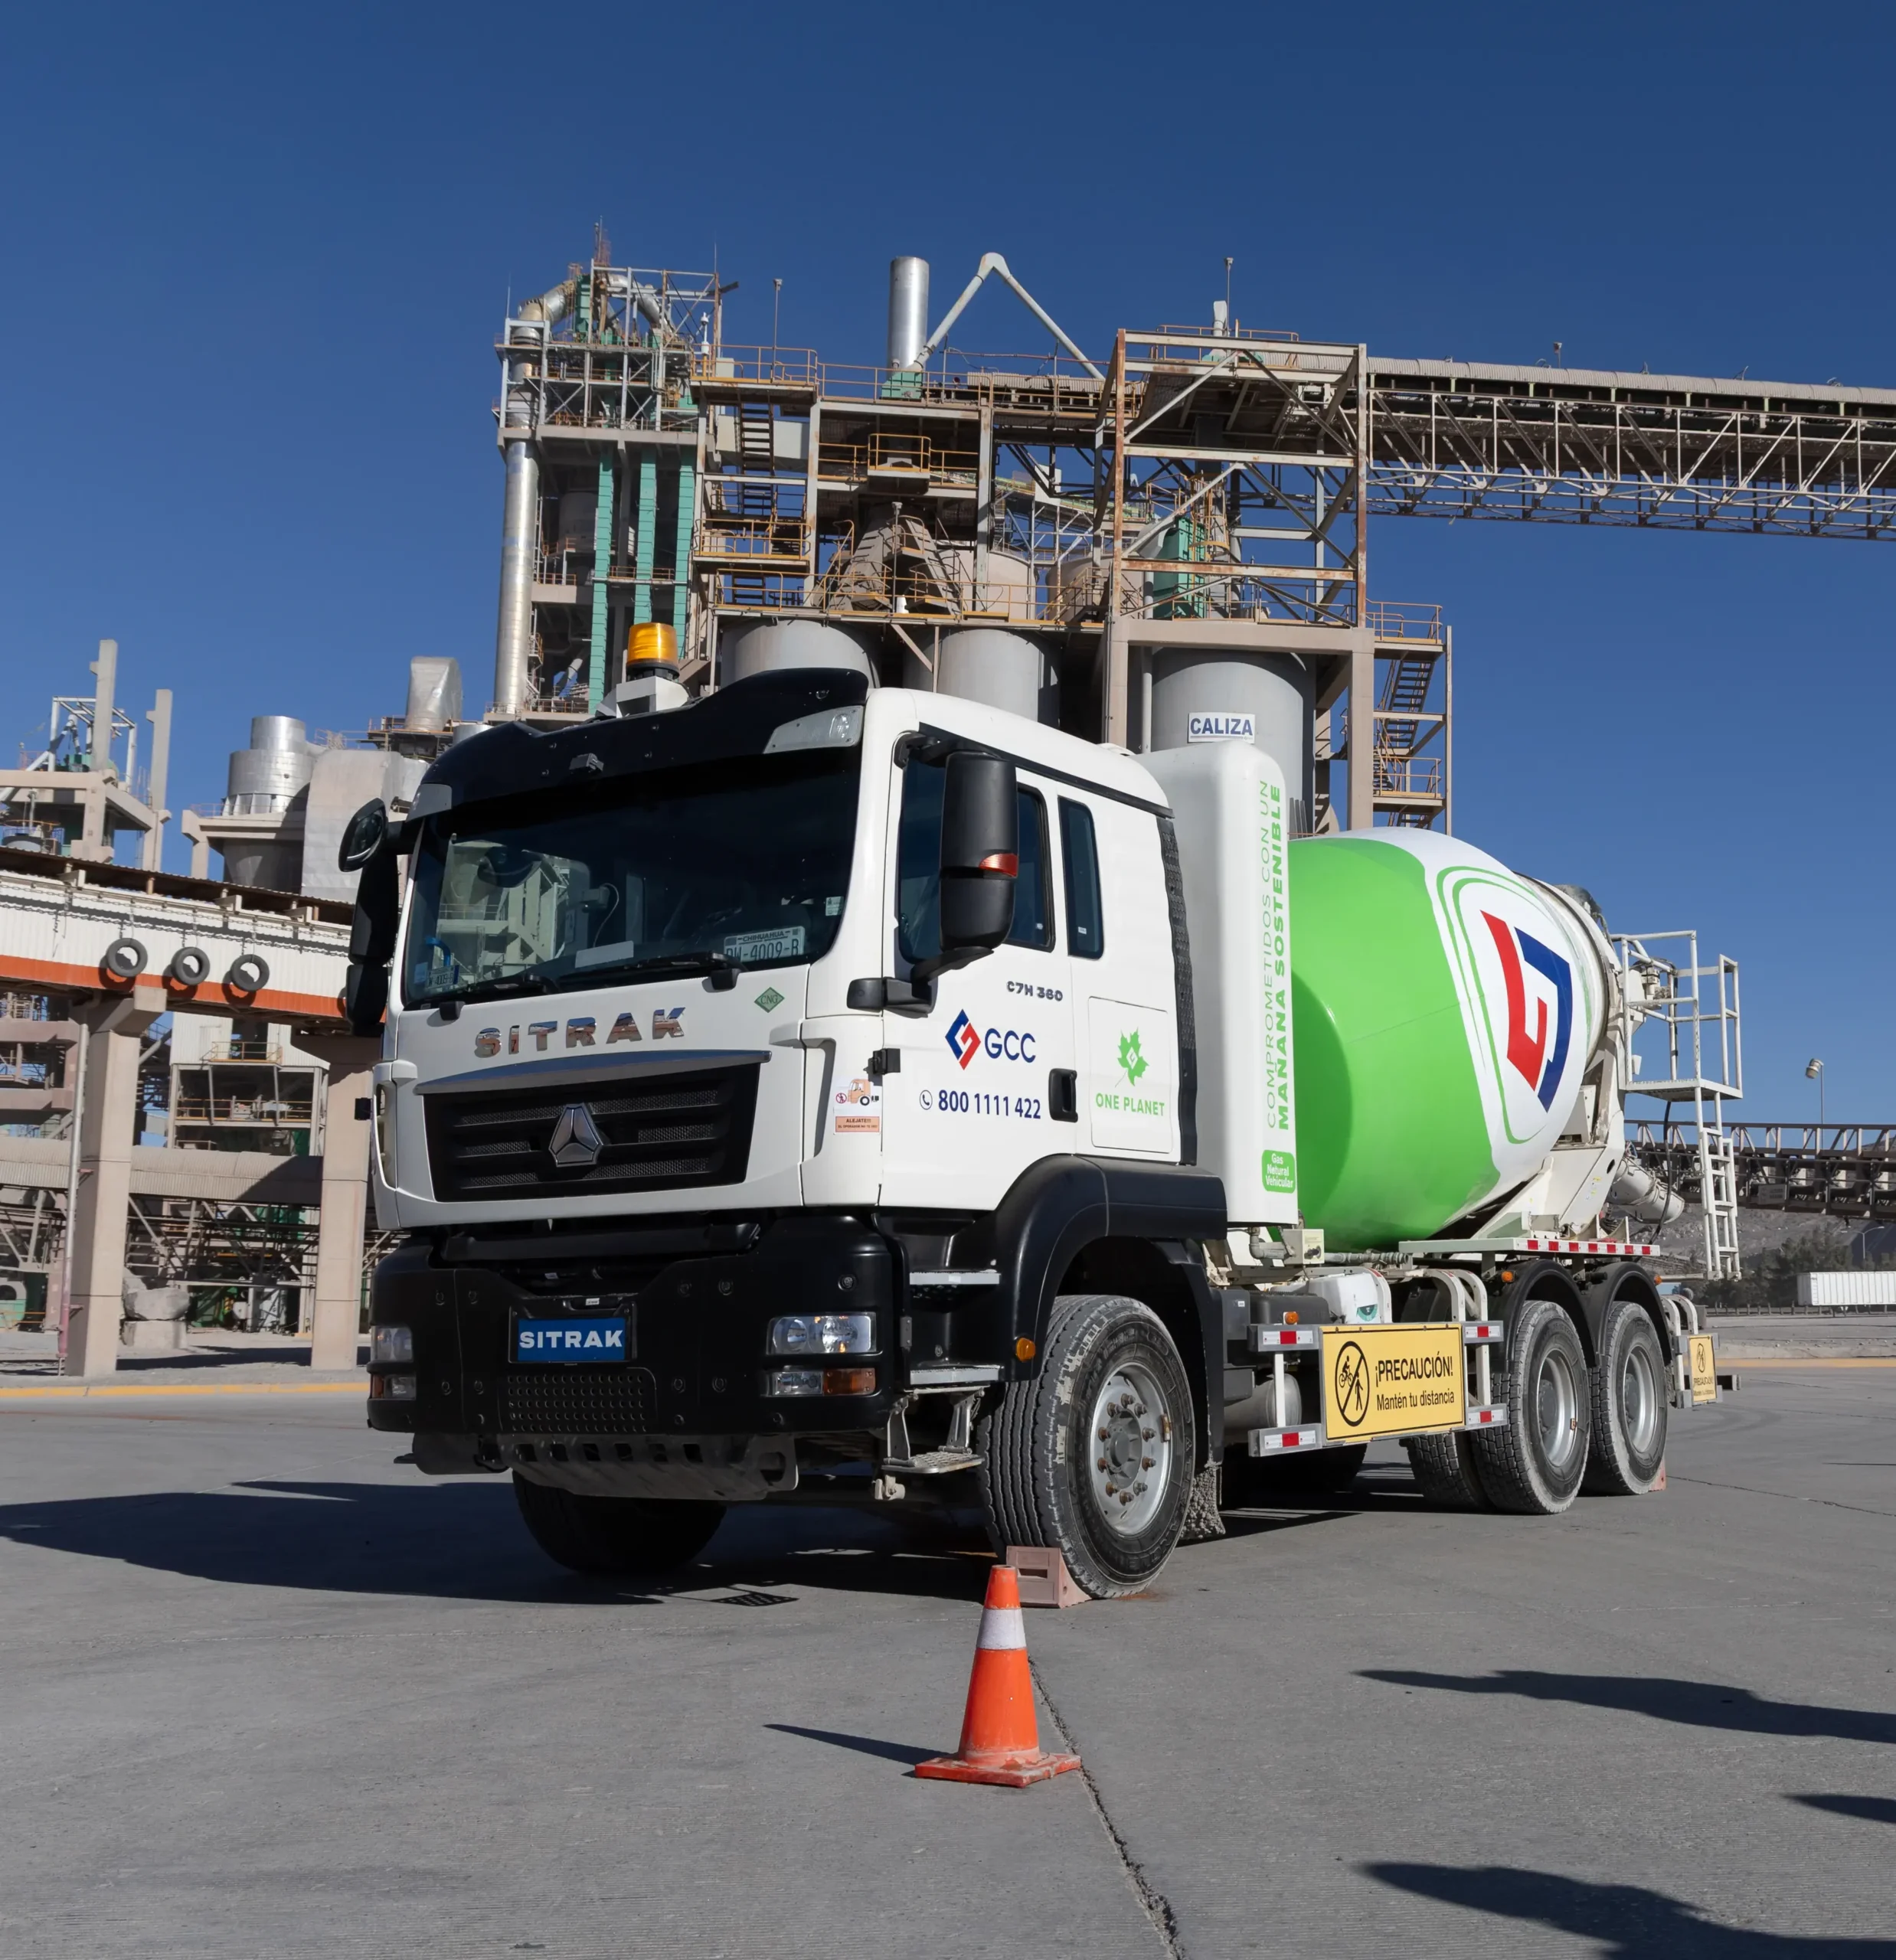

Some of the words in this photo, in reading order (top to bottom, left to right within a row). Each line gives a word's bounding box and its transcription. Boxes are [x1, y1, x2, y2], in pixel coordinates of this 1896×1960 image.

[1190, 717, 1254, 736] CALIZA
[1260, 780, 1269, 816] UN
[1260, 827, 1270, 883] CON
[1270, 784, 1285, 978] SOSTENIBLE
[742, 931, 785, 942] CHIHUAHUA
[760, 995, 778, 1004] CNG
[1006, 980, 1034, 997] C7H
[1036, 986, 1063, 1001] 380
[1262, 893, 1277, 1129] COMPROMETIDOS
[474, 1007, 686, 1058] SITRAK
[985, 1027, 1036, 1063] GCC
[1274, 989, 1289, 1131] MAÑANA
[938, 1089, 969, 1112] 800
[974, 1093, 1009, 1116] 1111
[1015, 1097, 1041, 1119] 422
[1096, 1093, 1119, 1110] ONE
[1124, 1097, 1165, 1116] PLANET
[1267, 1163, 1290, 1176] Natural
[1271, 1152, 1283, 1165] Gas
[1265, 1174, 1293, 1188] Vehicular
[519, 1330, 623, 1348] SITRAK
[1375, 1351, 1453, 1387] ¡PRECAUCIÓN!
[1377, 1392, 1407, 1411] Mantén
[1409, 1392, 1417, 1407] tu
[1420, 1388, 1454, 1406] distancia
